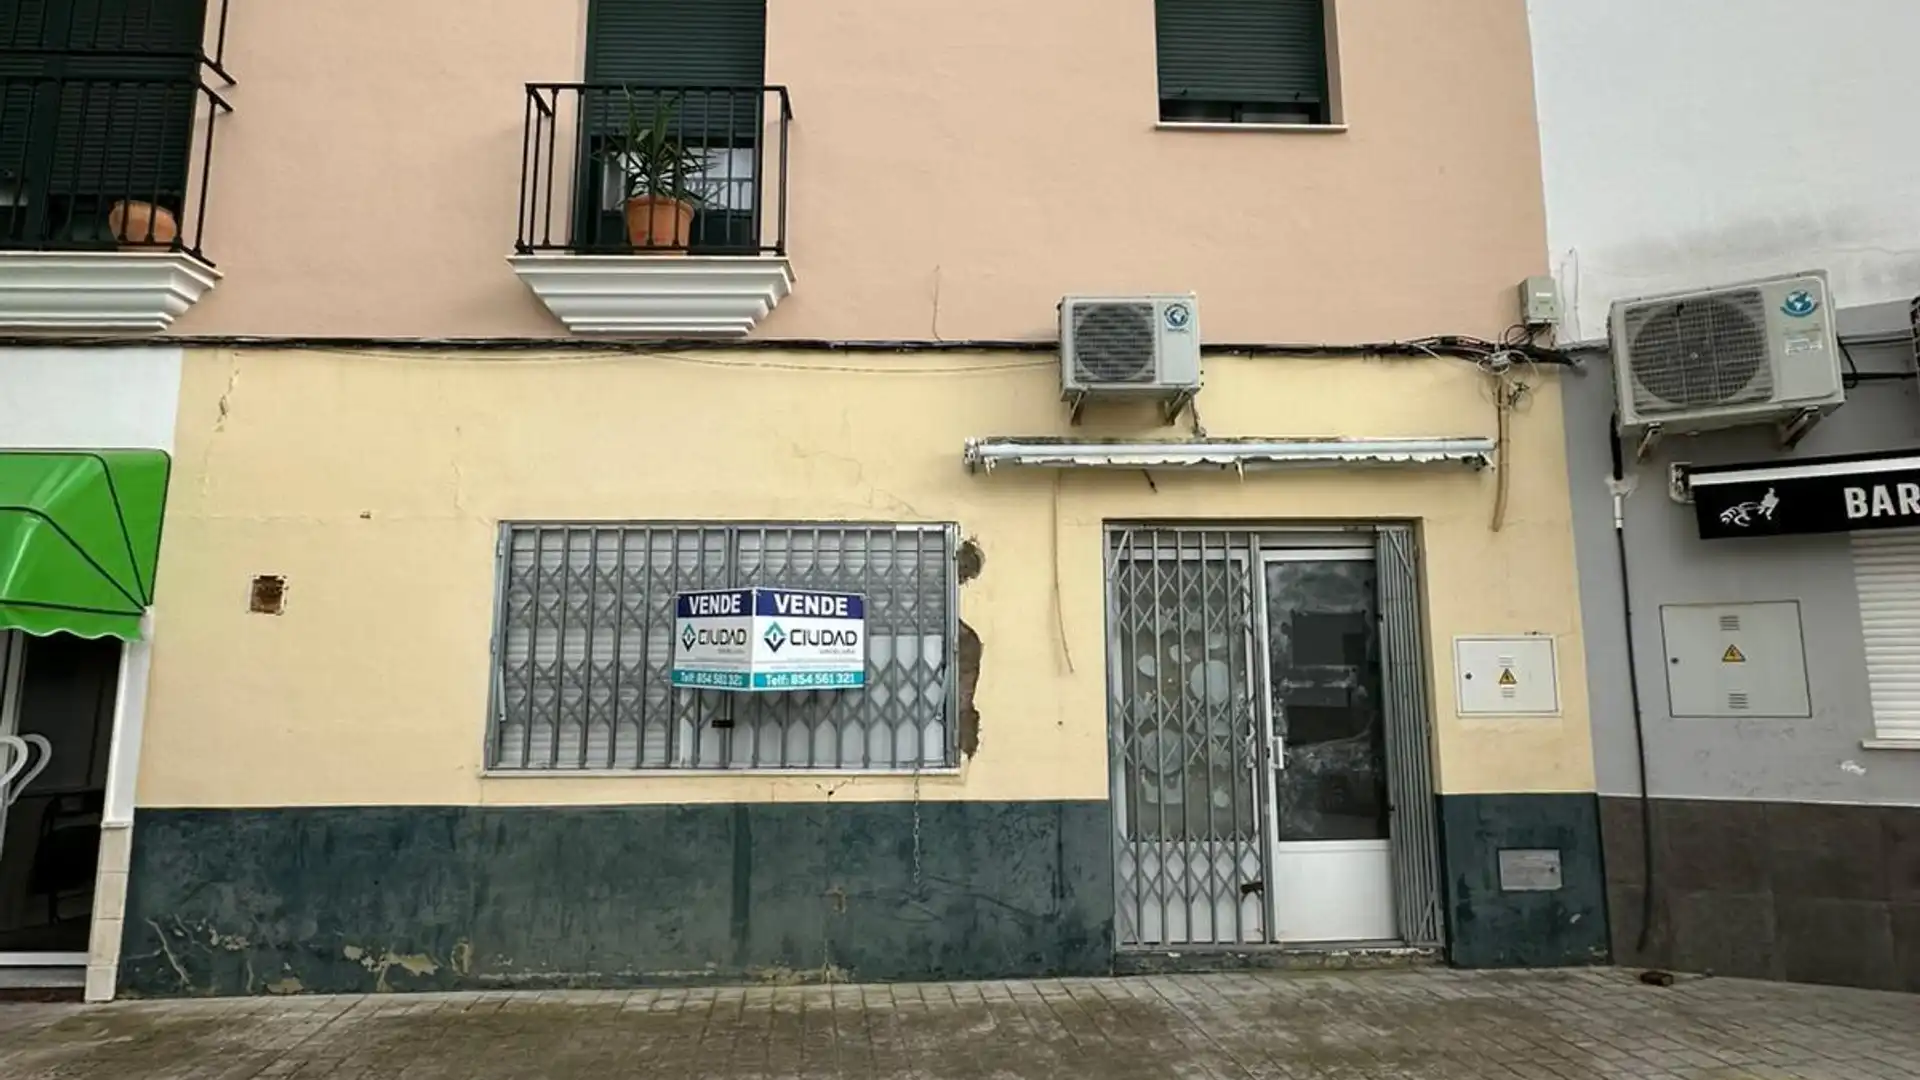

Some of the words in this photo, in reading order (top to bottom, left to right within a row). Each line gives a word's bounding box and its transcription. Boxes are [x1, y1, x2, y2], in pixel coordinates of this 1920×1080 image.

[1844, 483, 1920, 518] BAR
[688, 594, 741, 615] VENDE
[774, 593, 848, 616] VENDE
[698, 628, 747, 646] CIUDAD
[790, 628, 858, 646] CIUDAD
[791, 672, 813, 685] 854
[814, 672, 834, 685] 561
[836, 671, 855, 684] 321
